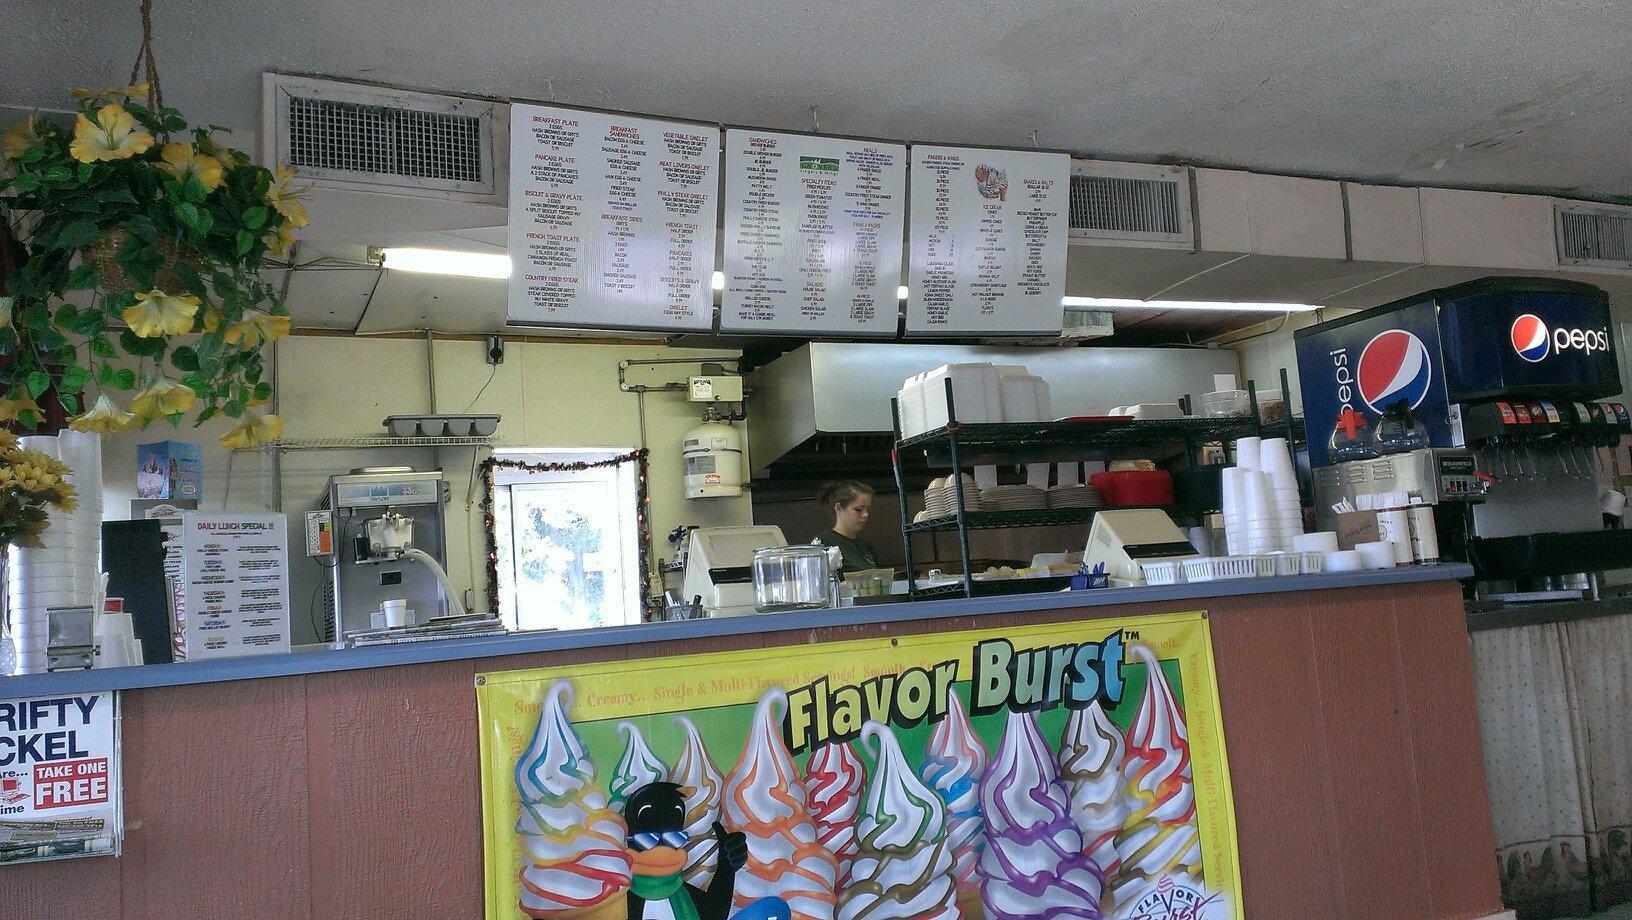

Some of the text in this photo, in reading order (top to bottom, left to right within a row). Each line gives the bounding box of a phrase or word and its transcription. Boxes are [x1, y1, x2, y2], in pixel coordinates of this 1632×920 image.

[533, 116, 561, 124] BREAKFAST
[609, 131, 640, 139] SANDWICHES
[611, 125, 637, 133] BREAKFAST
[663, 132, 689, 140] VEGETABLE
[601, 213, 628, 221] BREAKFAST
[1554, 326, 1610, 355] pepsi
[653, 684, 692, 703] Single
[697, 682, 709, 694] &
[711, 672, 800, 693] Multi-Flavored
[787, 659, 959, 753] Flavor
[970, 628, 1126, 717] Burst
[37, 762, 107, 779] TAKE ONE
[36, 777, 107, 806] FREE
